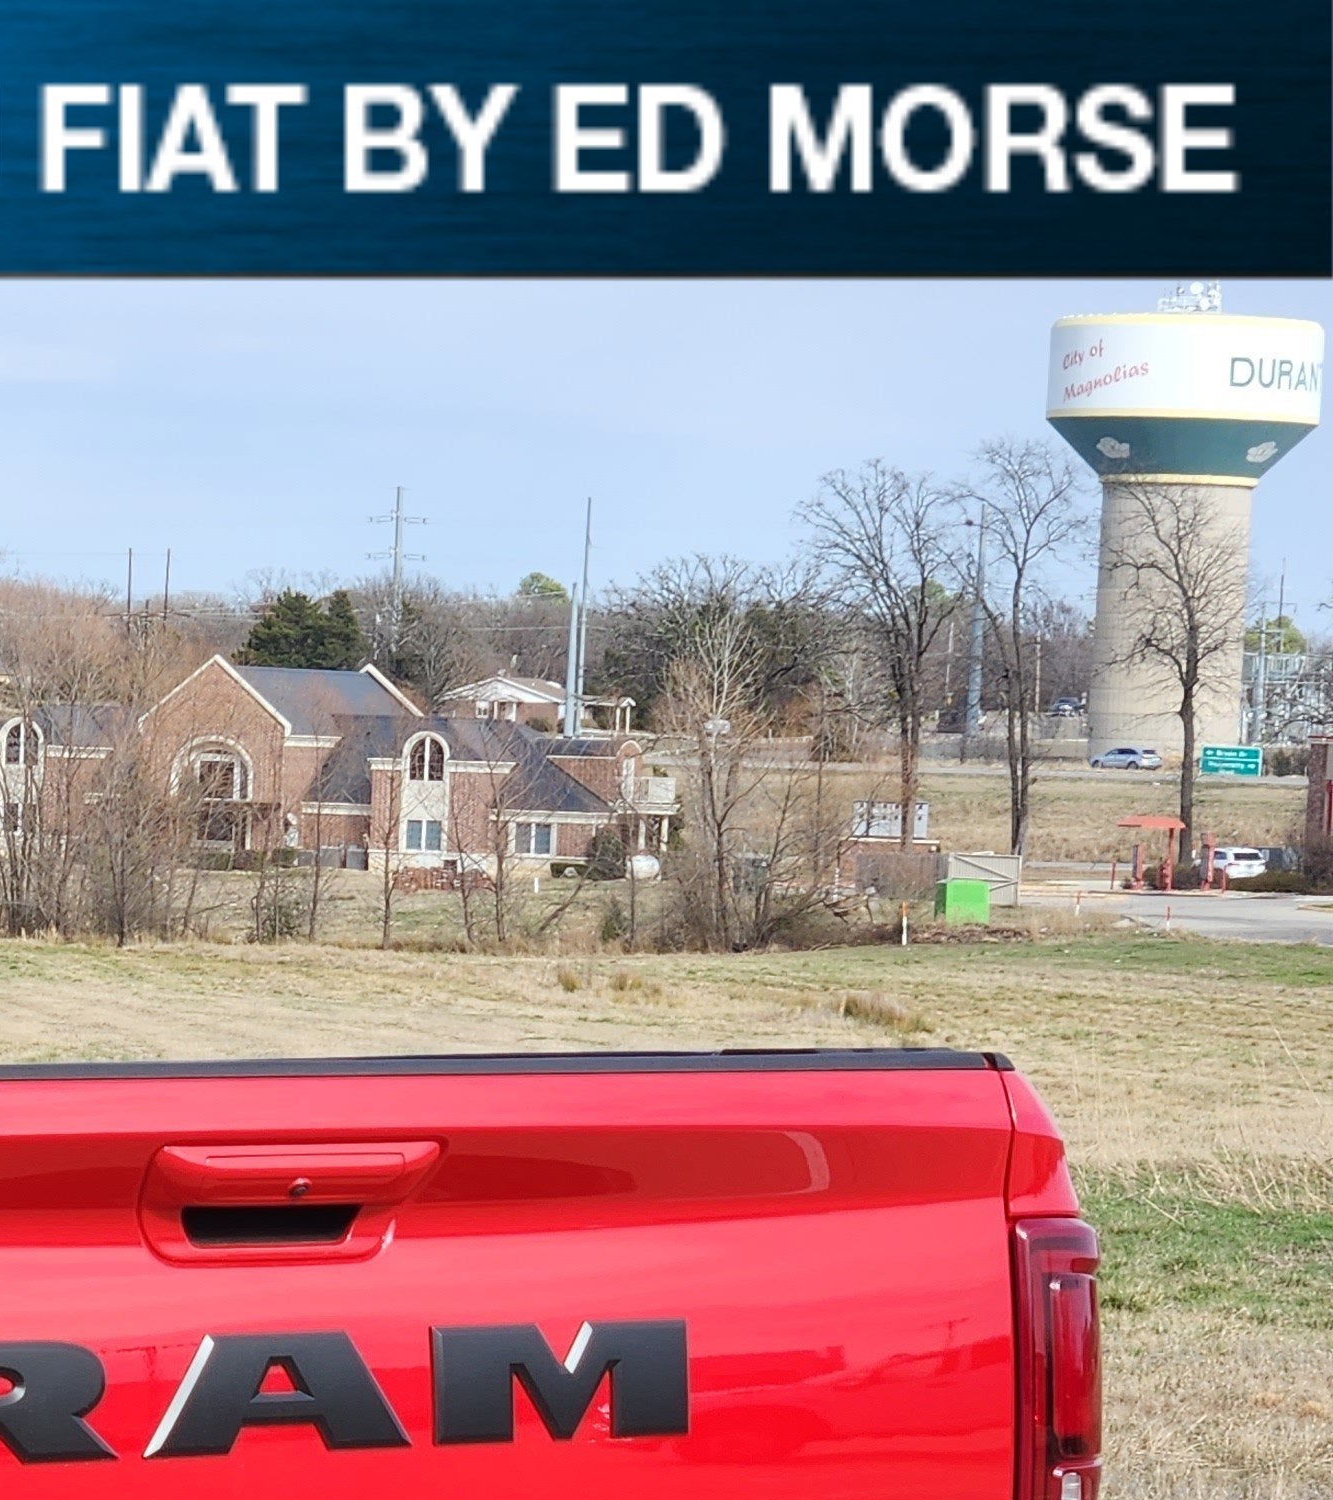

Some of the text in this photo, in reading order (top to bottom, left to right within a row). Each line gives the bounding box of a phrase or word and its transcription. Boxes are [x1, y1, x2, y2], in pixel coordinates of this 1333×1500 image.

[1062, 338, 1104, 371] City of
[1061, 361, 1150, 403] Magnolias
